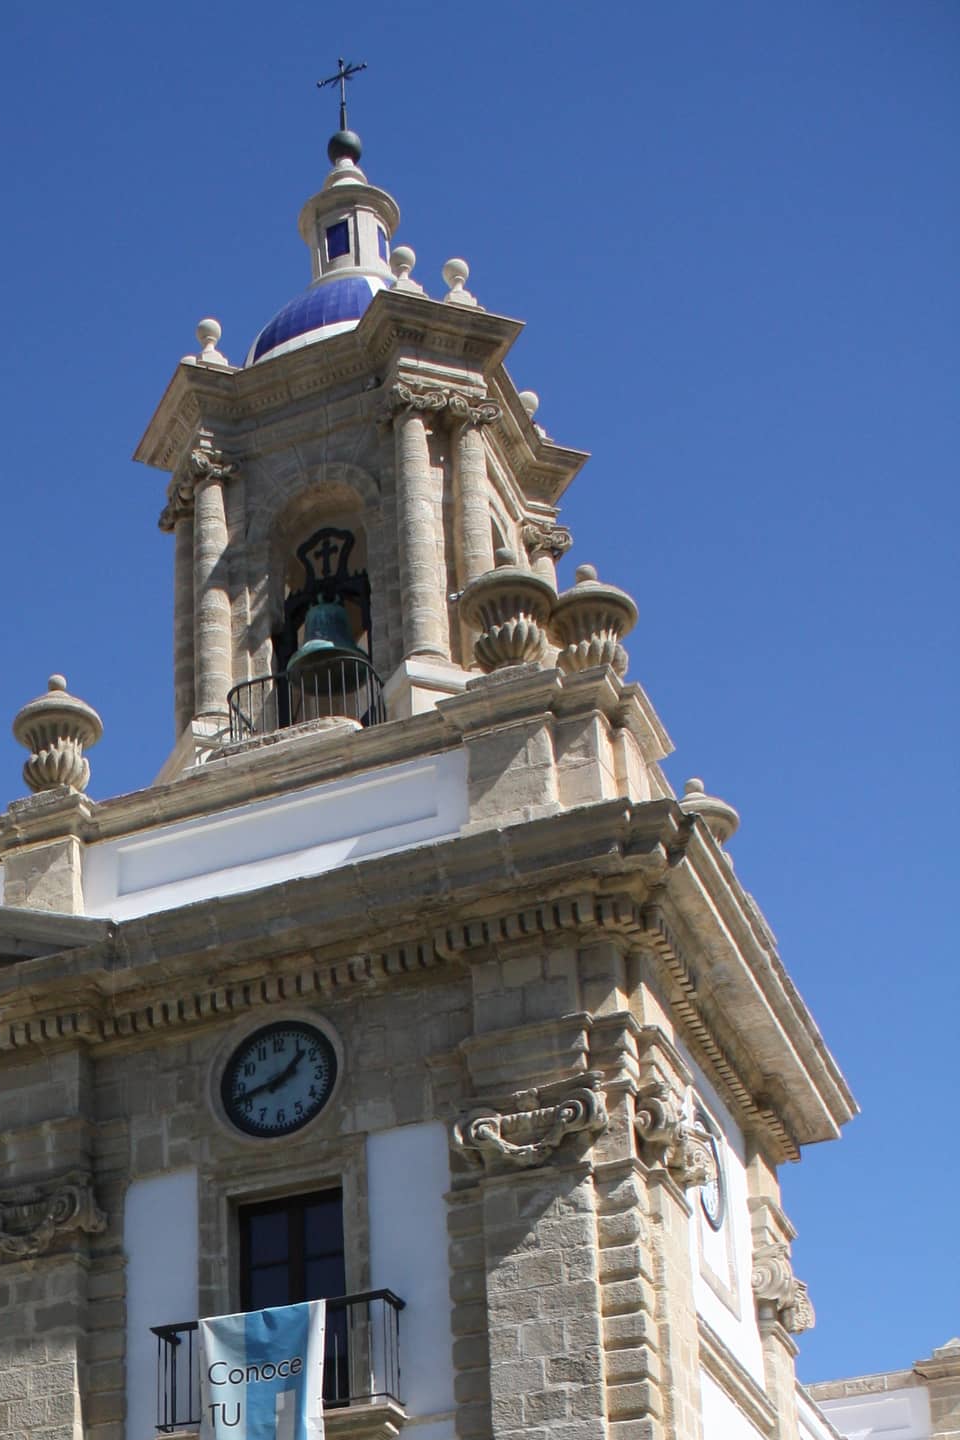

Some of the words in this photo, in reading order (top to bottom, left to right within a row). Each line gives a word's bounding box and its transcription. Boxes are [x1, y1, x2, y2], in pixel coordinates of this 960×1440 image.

[273, 1037, 285, 1053] 12
[258, 1046, 266, 1061] 11
[308, 1047, 317, 1062] 2
[244, 1062, 256, 1077] 10
[314, 1065, 324, 1080] 3
[308, 1084, 317, 1098] 4
[244, 1098, 253, 1113] 8
[294, 1100, 303, 1115] 5
[259, 1107, 268, 1121] 7
[276, 1109, 285, 1122] 6
[208, 1357, 303, 1386] Conoce
[208, 1402, 240, 1428] TU
